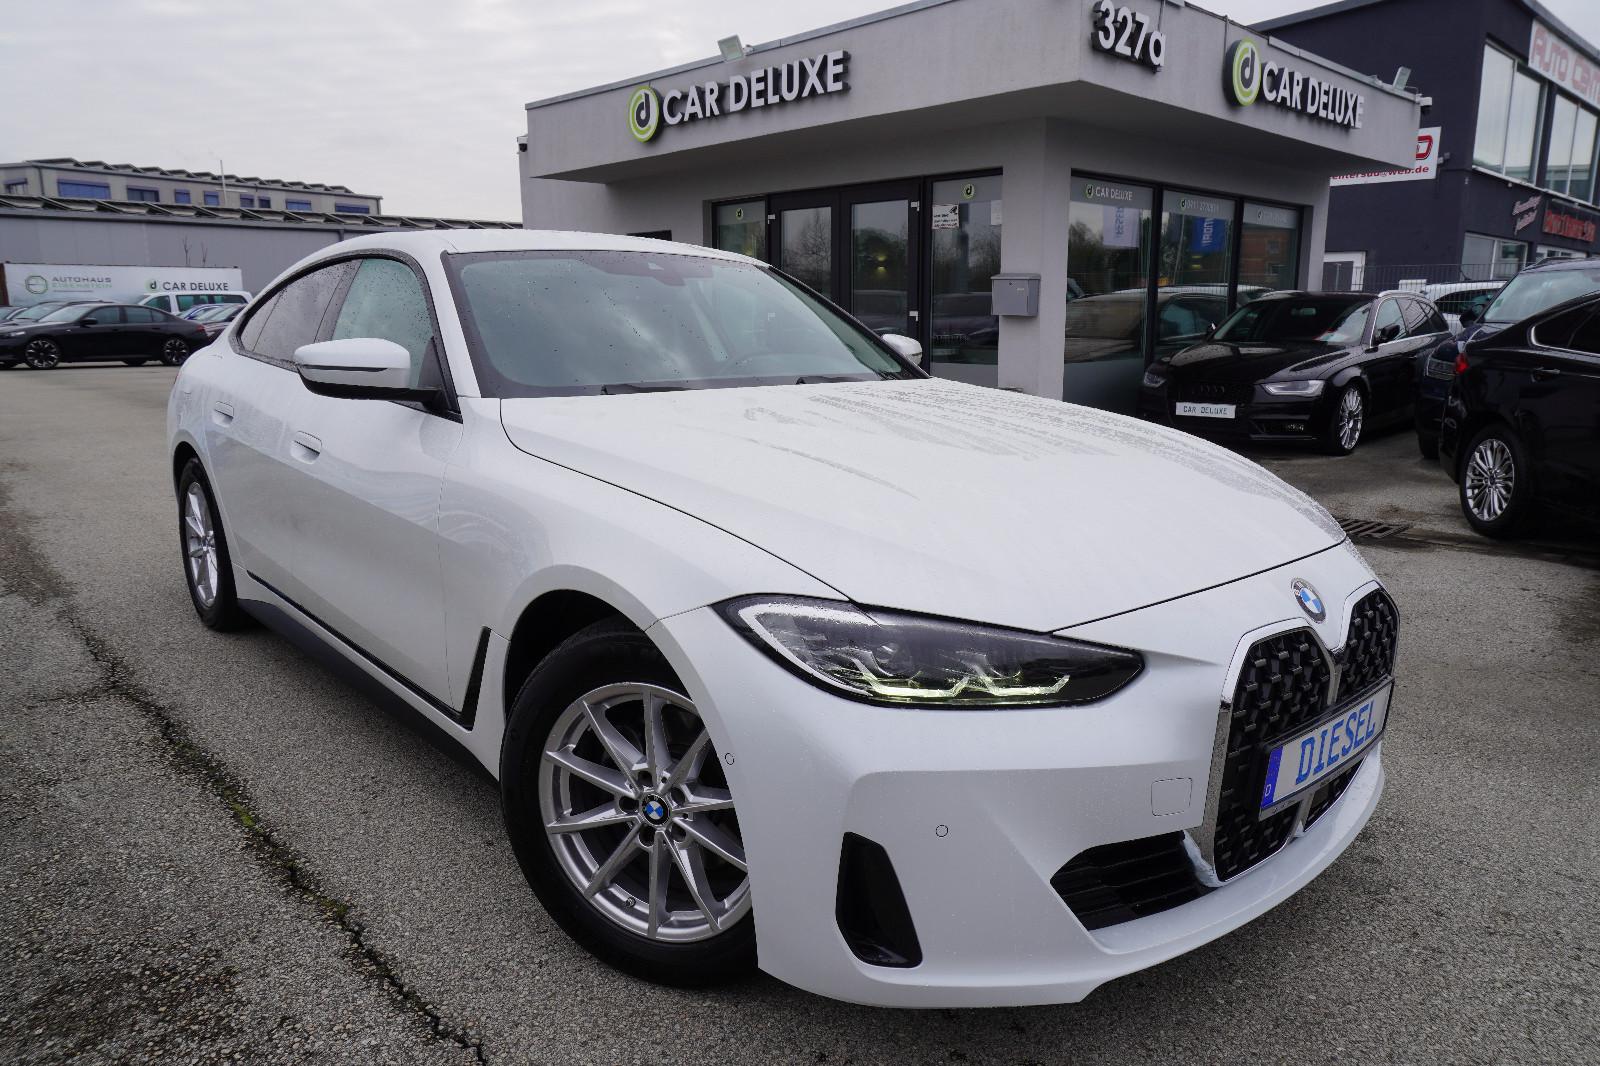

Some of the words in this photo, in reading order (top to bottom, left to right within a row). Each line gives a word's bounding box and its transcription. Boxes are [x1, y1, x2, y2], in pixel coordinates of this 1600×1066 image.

[1098, 0, 1167, 67] 327a
[662, 80, 720, 125] CAR
[729, 50, 846, 110] DELUXE
[1262, 60, 1303, 110] CAR
[1306, 76, 1365, 129] DELUXE
[1095, 186, 1110, 198] CAR
[1110, 188, 1133, 201] DELUXE
[162, 281, 186, 291] CAR
[190, 282, 229, 291] DELUXE
[1183, 405, 1197, 413] CAR
[1200, 406, 1228, 415] DELUXE
[1295, 699, 1375, 785] DIESEL
